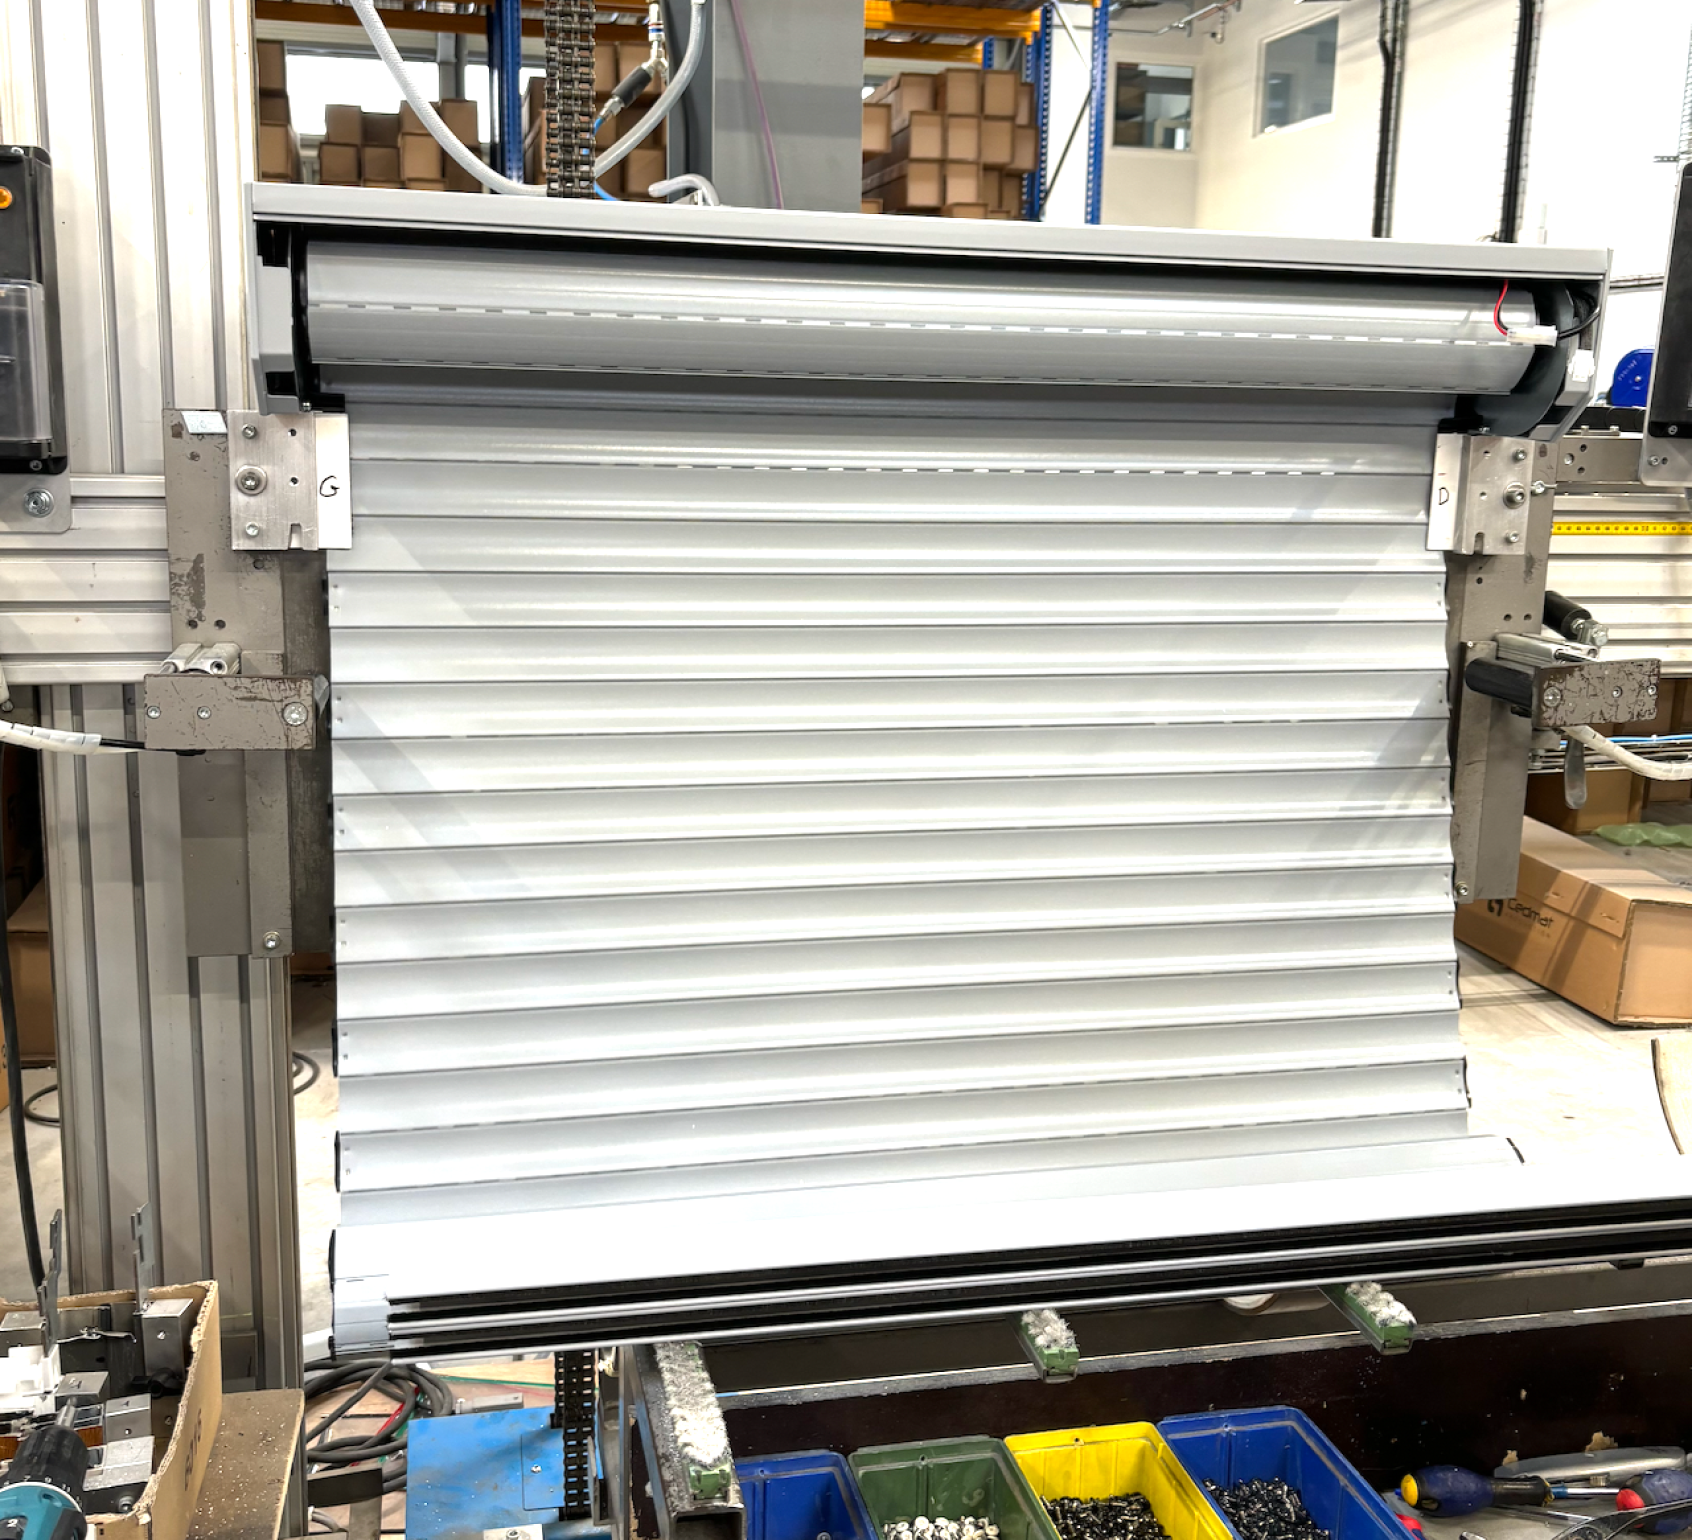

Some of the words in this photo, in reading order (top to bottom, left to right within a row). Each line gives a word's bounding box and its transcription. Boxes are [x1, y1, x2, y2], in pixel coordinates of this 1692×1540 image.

[319, 475, 341, 498] G
[1438, 486, 1450, 506] D
[6, 1518, 19, 1528] 2
